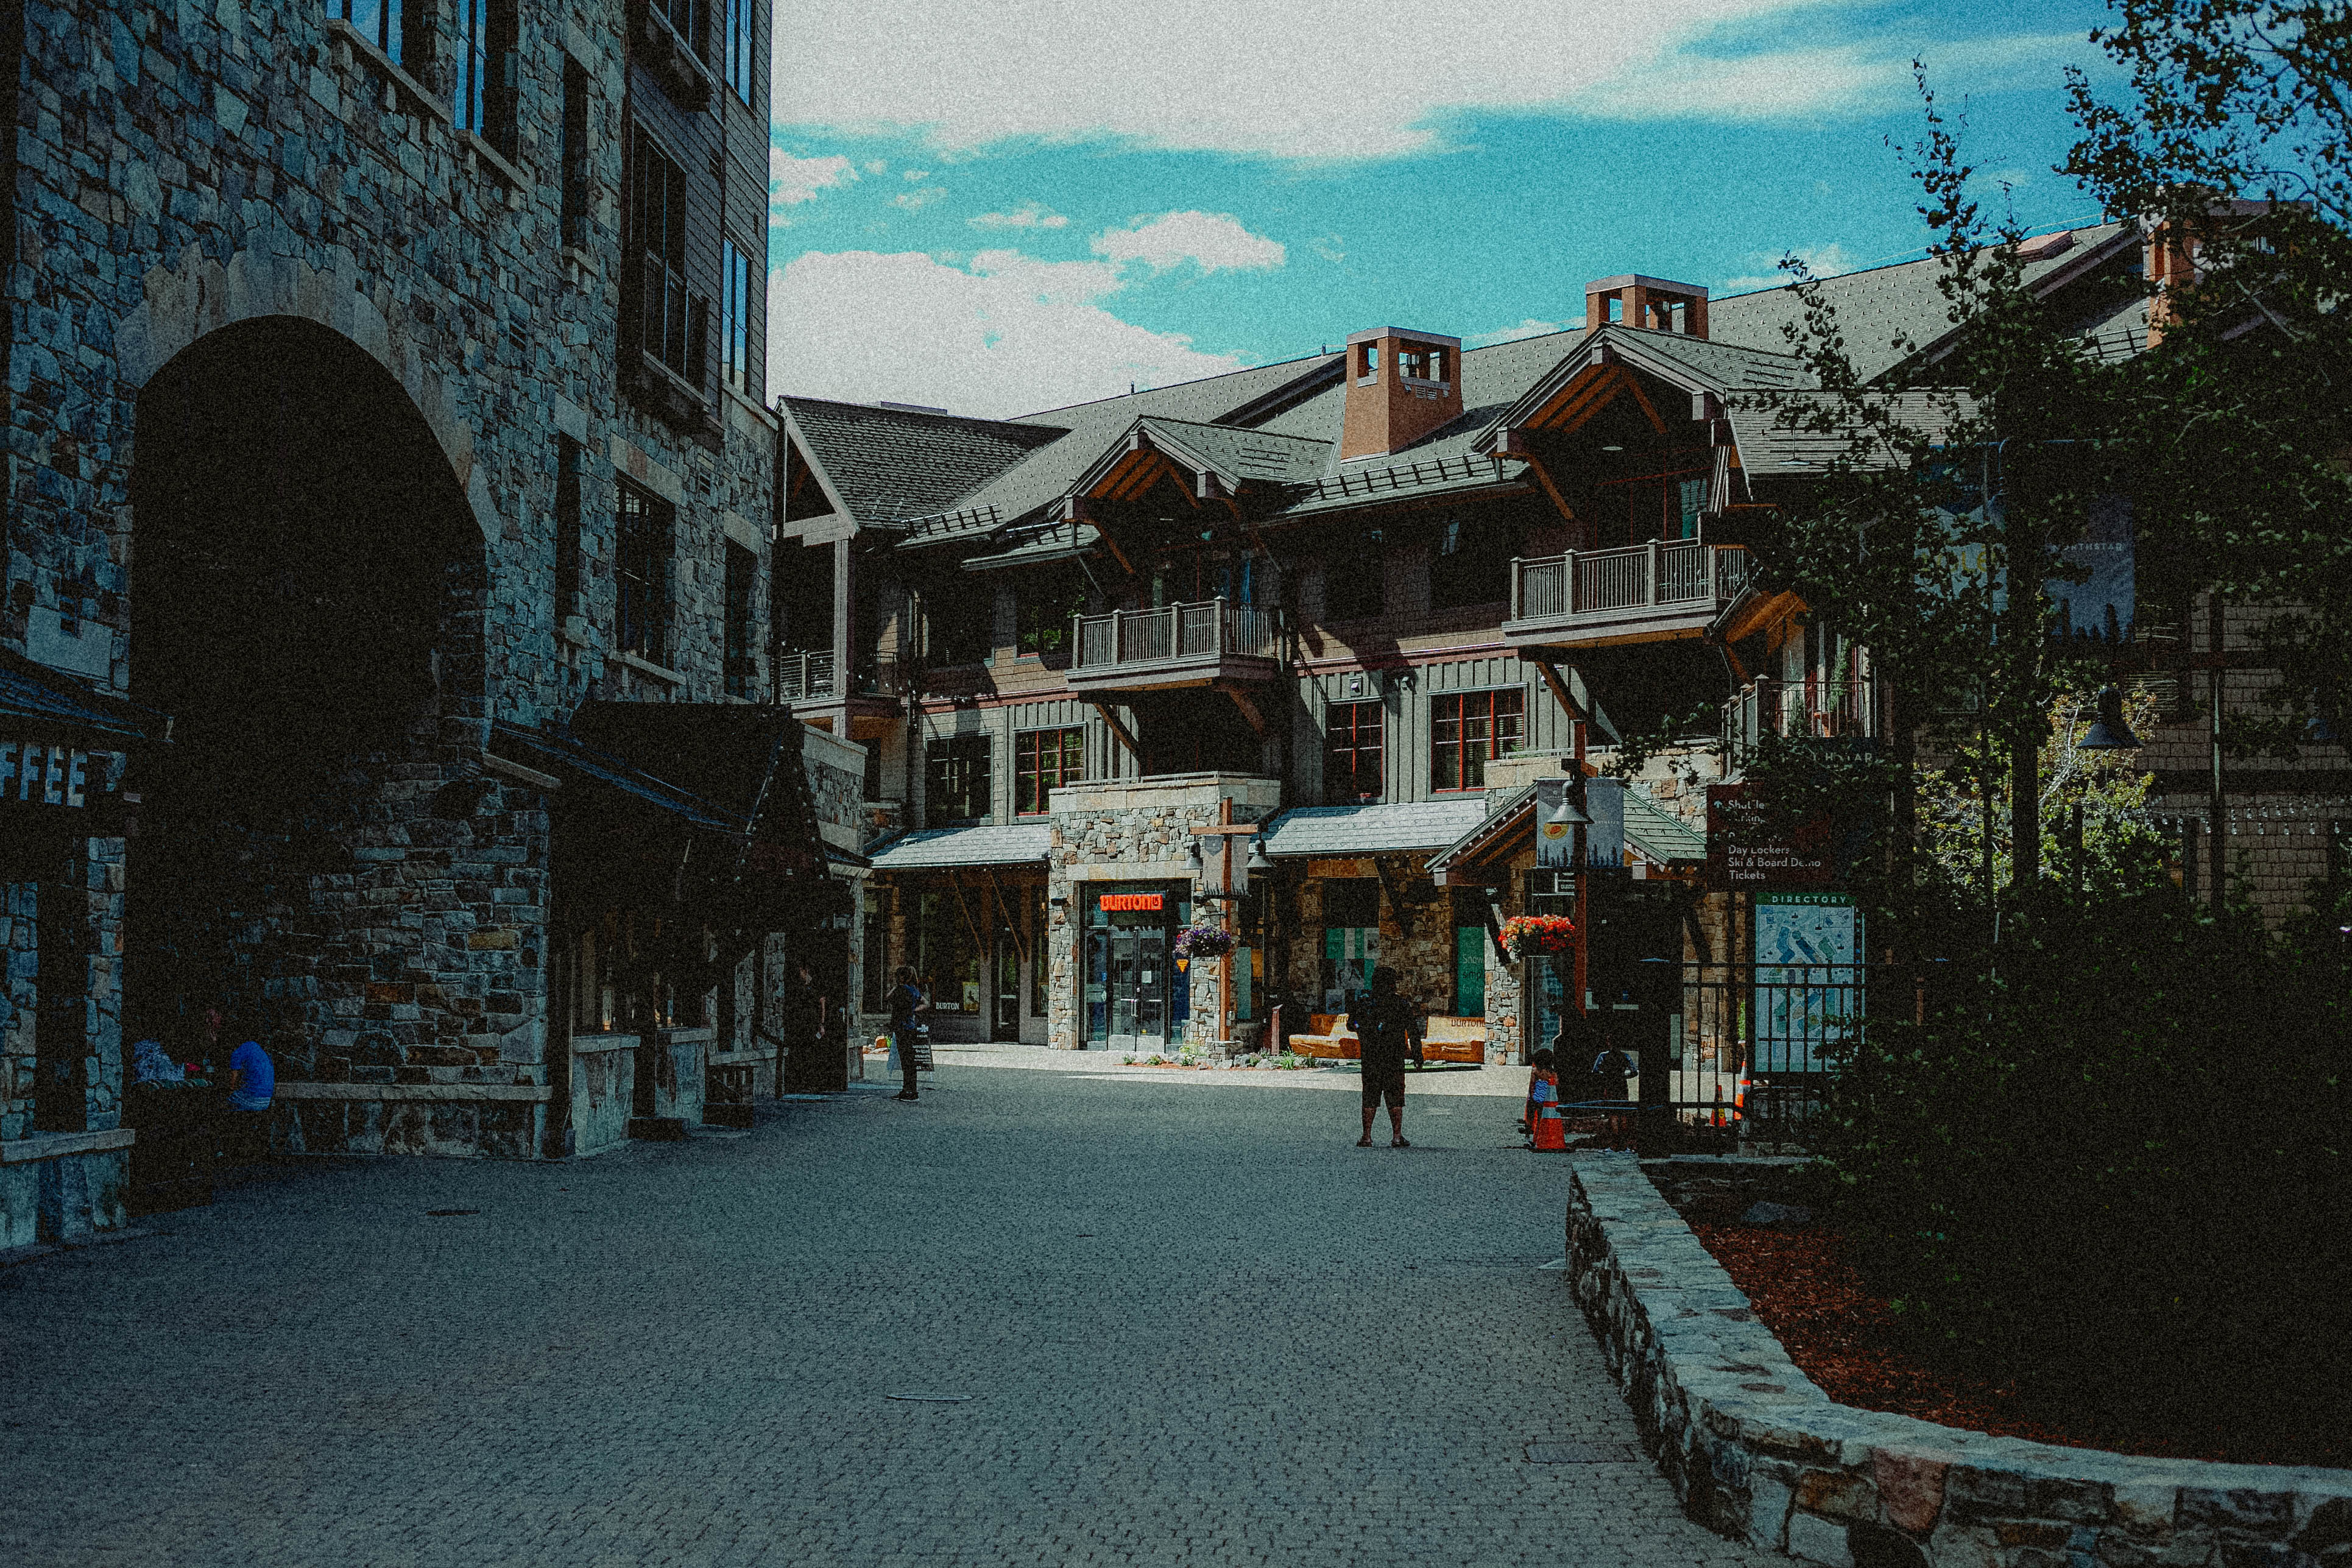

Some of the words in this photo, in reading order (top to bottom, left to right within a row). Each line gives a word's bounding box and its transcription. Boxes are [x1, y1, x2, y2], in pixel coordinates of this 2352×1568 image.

[1728, 799, 1765, 810] Shutle
[1728, 845, 1748, 856] Day
[1751, 844, 1790, 854] Lockers
[1728, 857, 1744, 867] Ski
[1746, 857, 1754, 867] &
[1757, 857, 1788, 867] Board
[1729, 870, 1766, 880] Tickets
[1100, 894, 1151, 911] BURTON
[936, 1001, 960, 1010] BURTON
